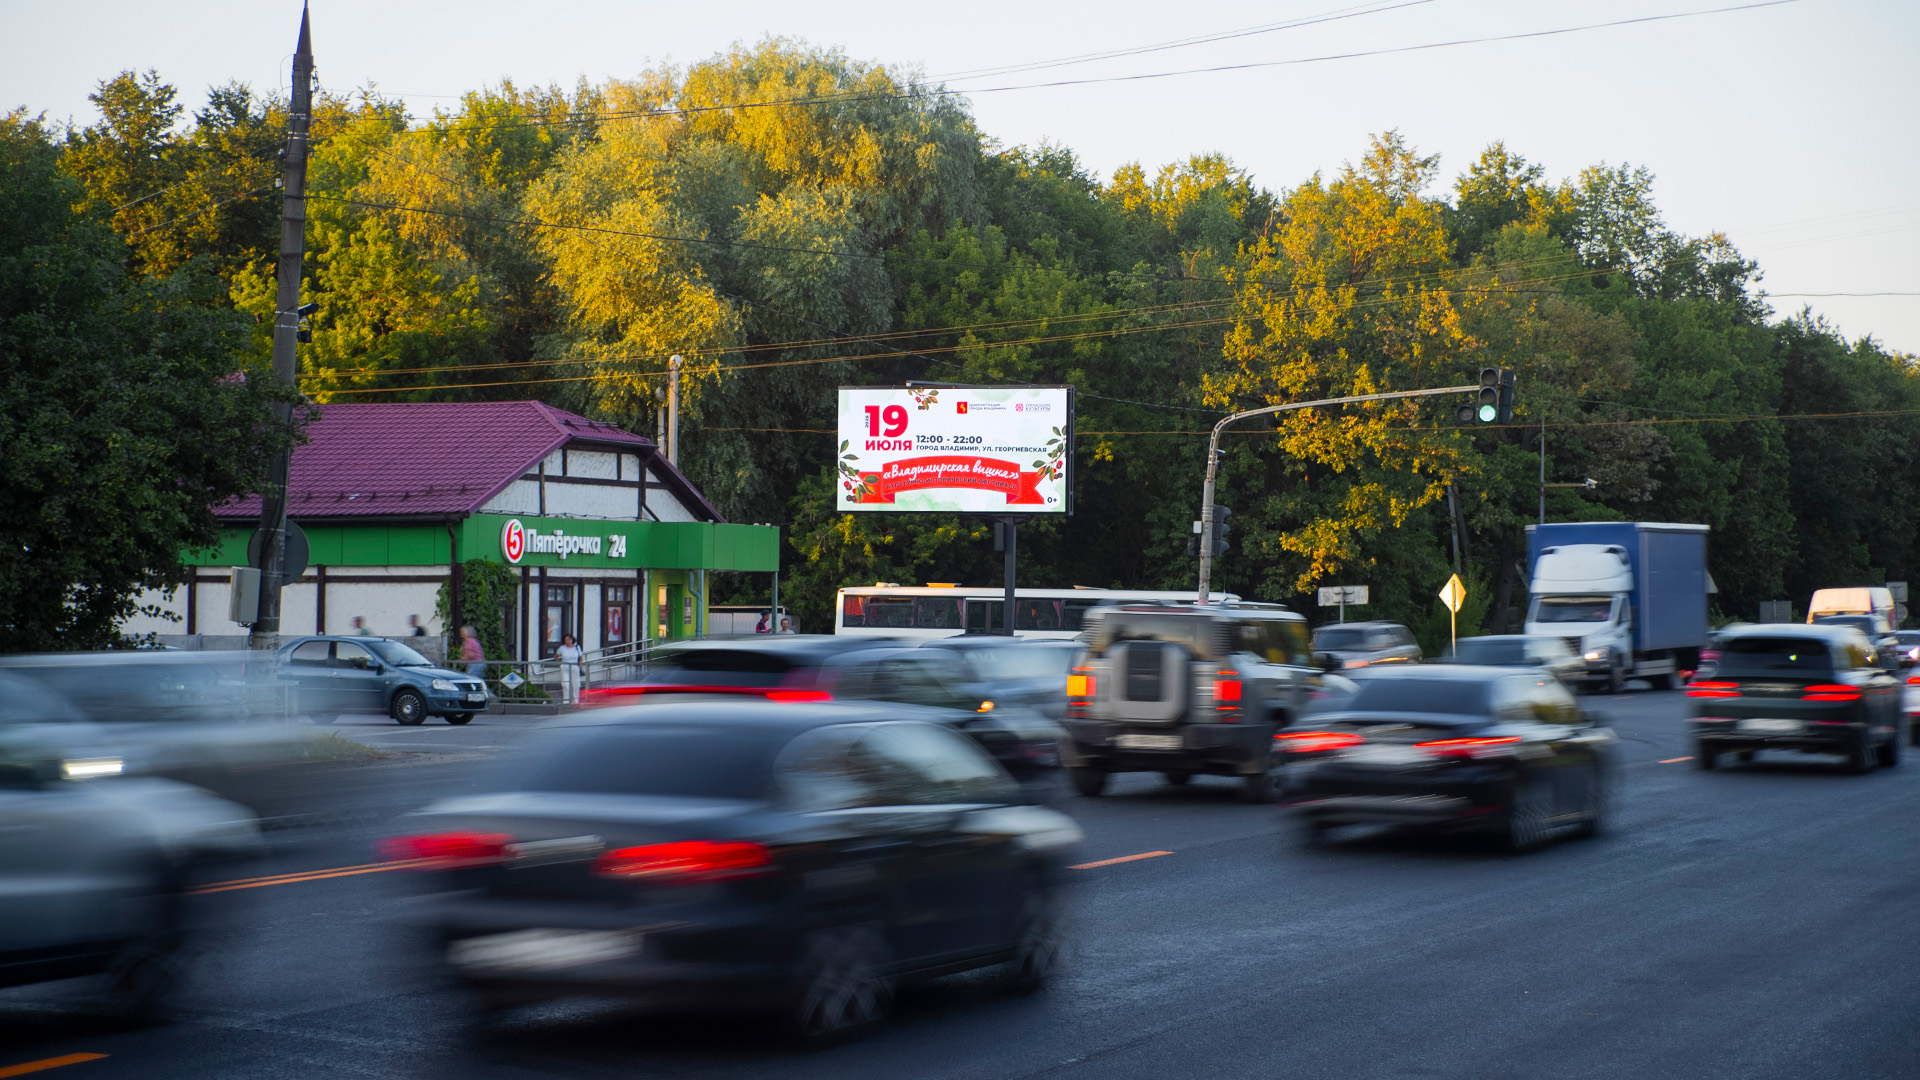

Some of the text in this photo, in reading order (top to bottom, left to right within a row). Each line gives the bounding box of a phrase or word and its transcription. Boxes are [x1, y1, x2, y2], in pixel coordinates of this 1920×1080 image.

[864, 405, 909, 438] 19
[865, 440, 913, 451] ИЮЛЯ
[916, 435, 944, 443] 12:00
[953, 436, 983, 444] 22:00
[883, 459, 1019, 481] «Владимирская вишня»
[978, 478, 1017, 490] ФЕСТИВАЛЬ
[524, 528, 627, 560] Пятёрочка 24
